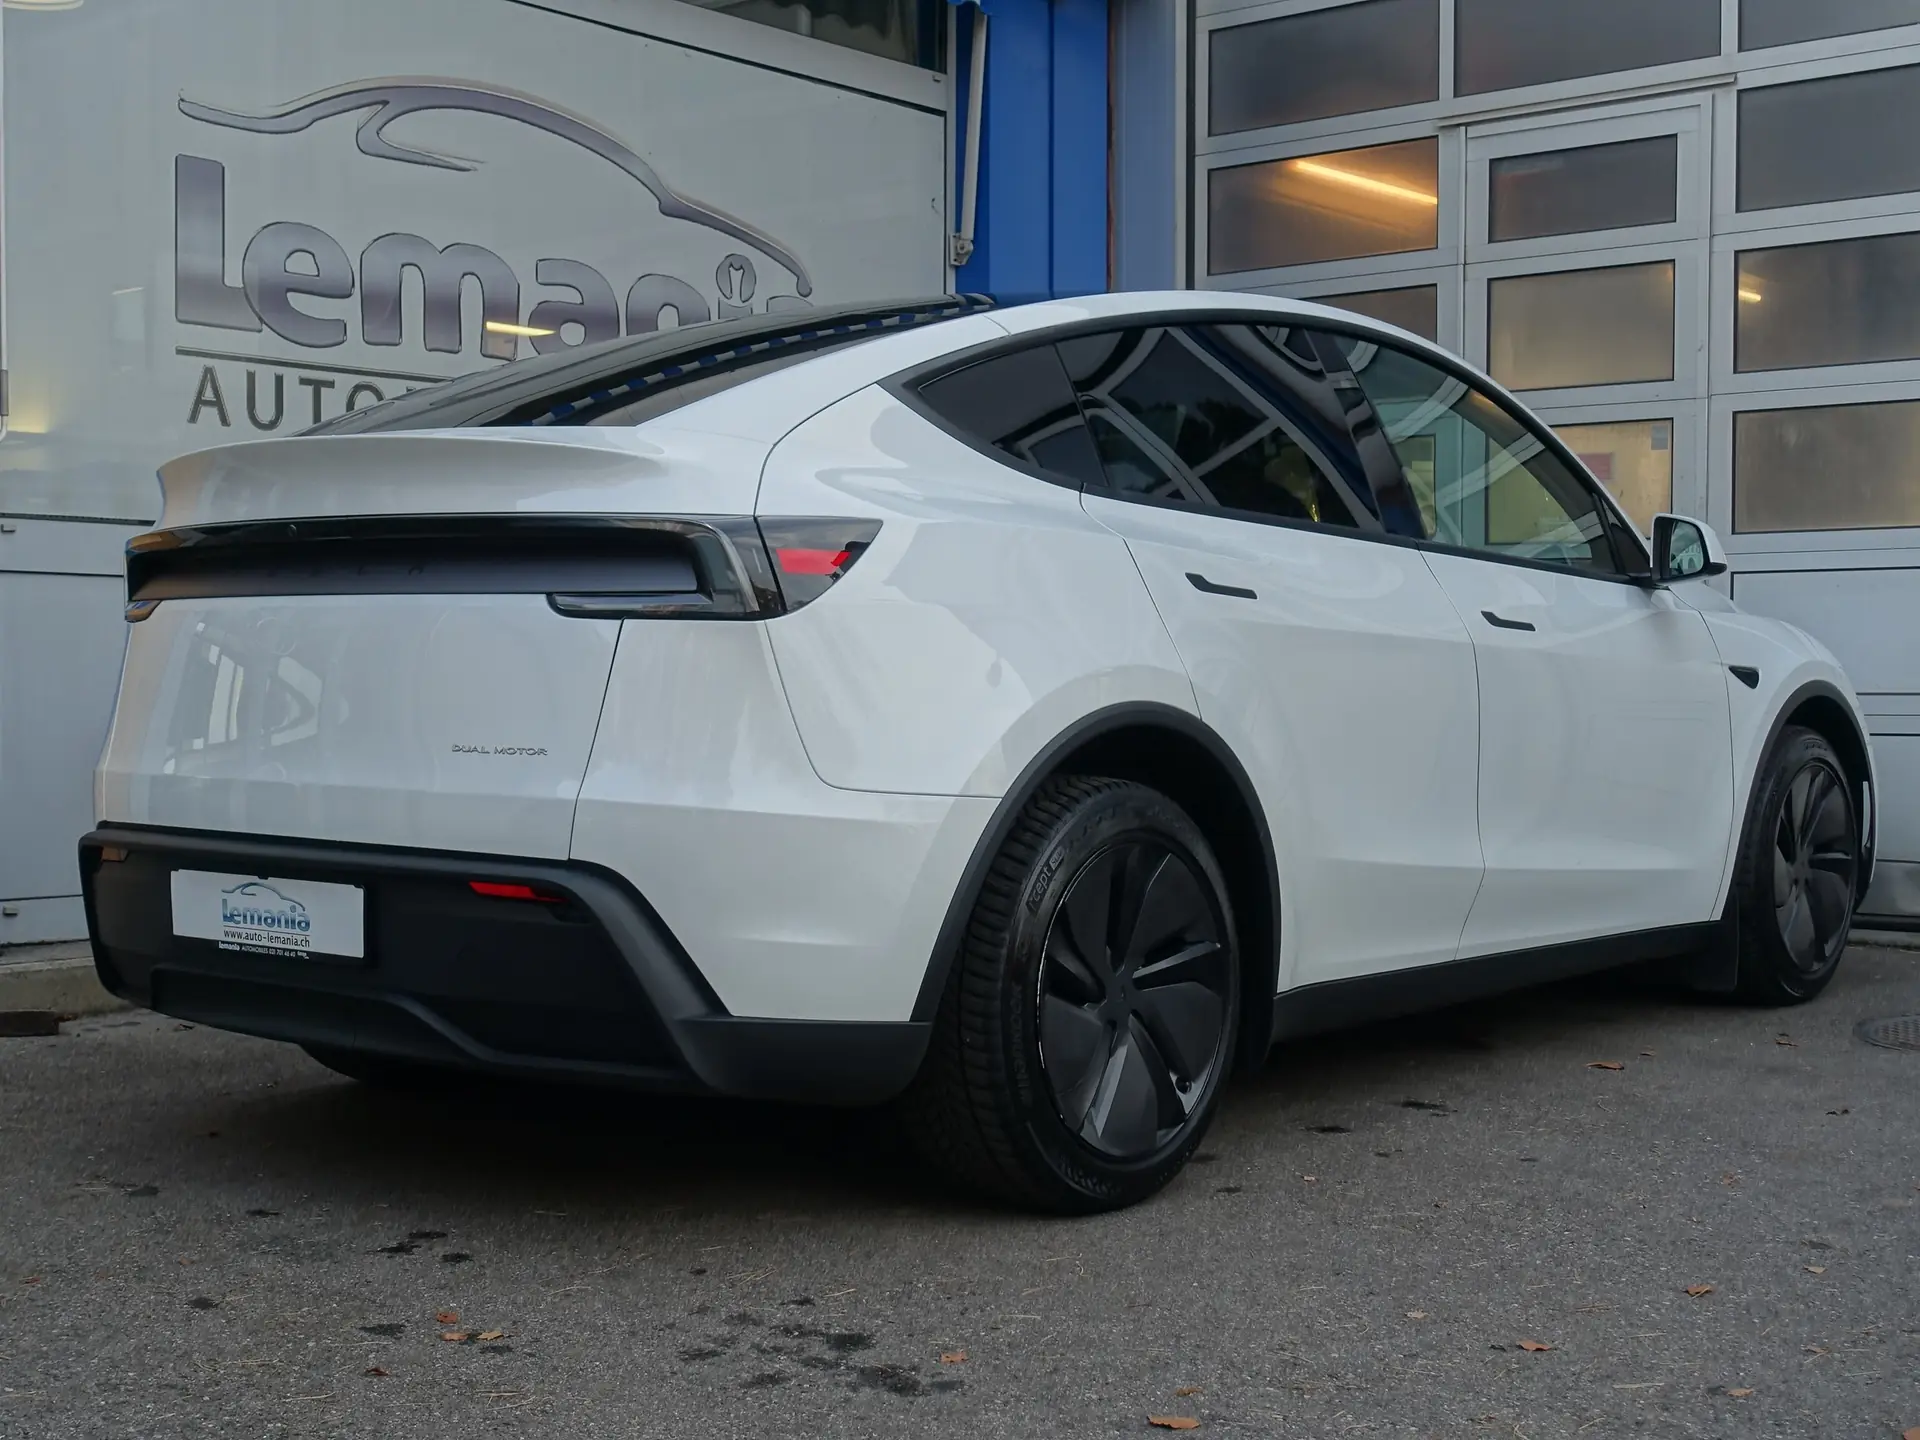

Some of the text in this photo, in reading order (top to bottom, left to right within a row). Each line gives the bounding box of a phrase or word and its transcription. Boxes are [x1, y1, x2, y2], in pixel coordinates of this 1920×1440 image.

[452, 744, 548, 756] DUAL MOTOR
[222, 899, 311, 931] Lemania
[223, 930, 310, 947] www.auto-lemania.ch
